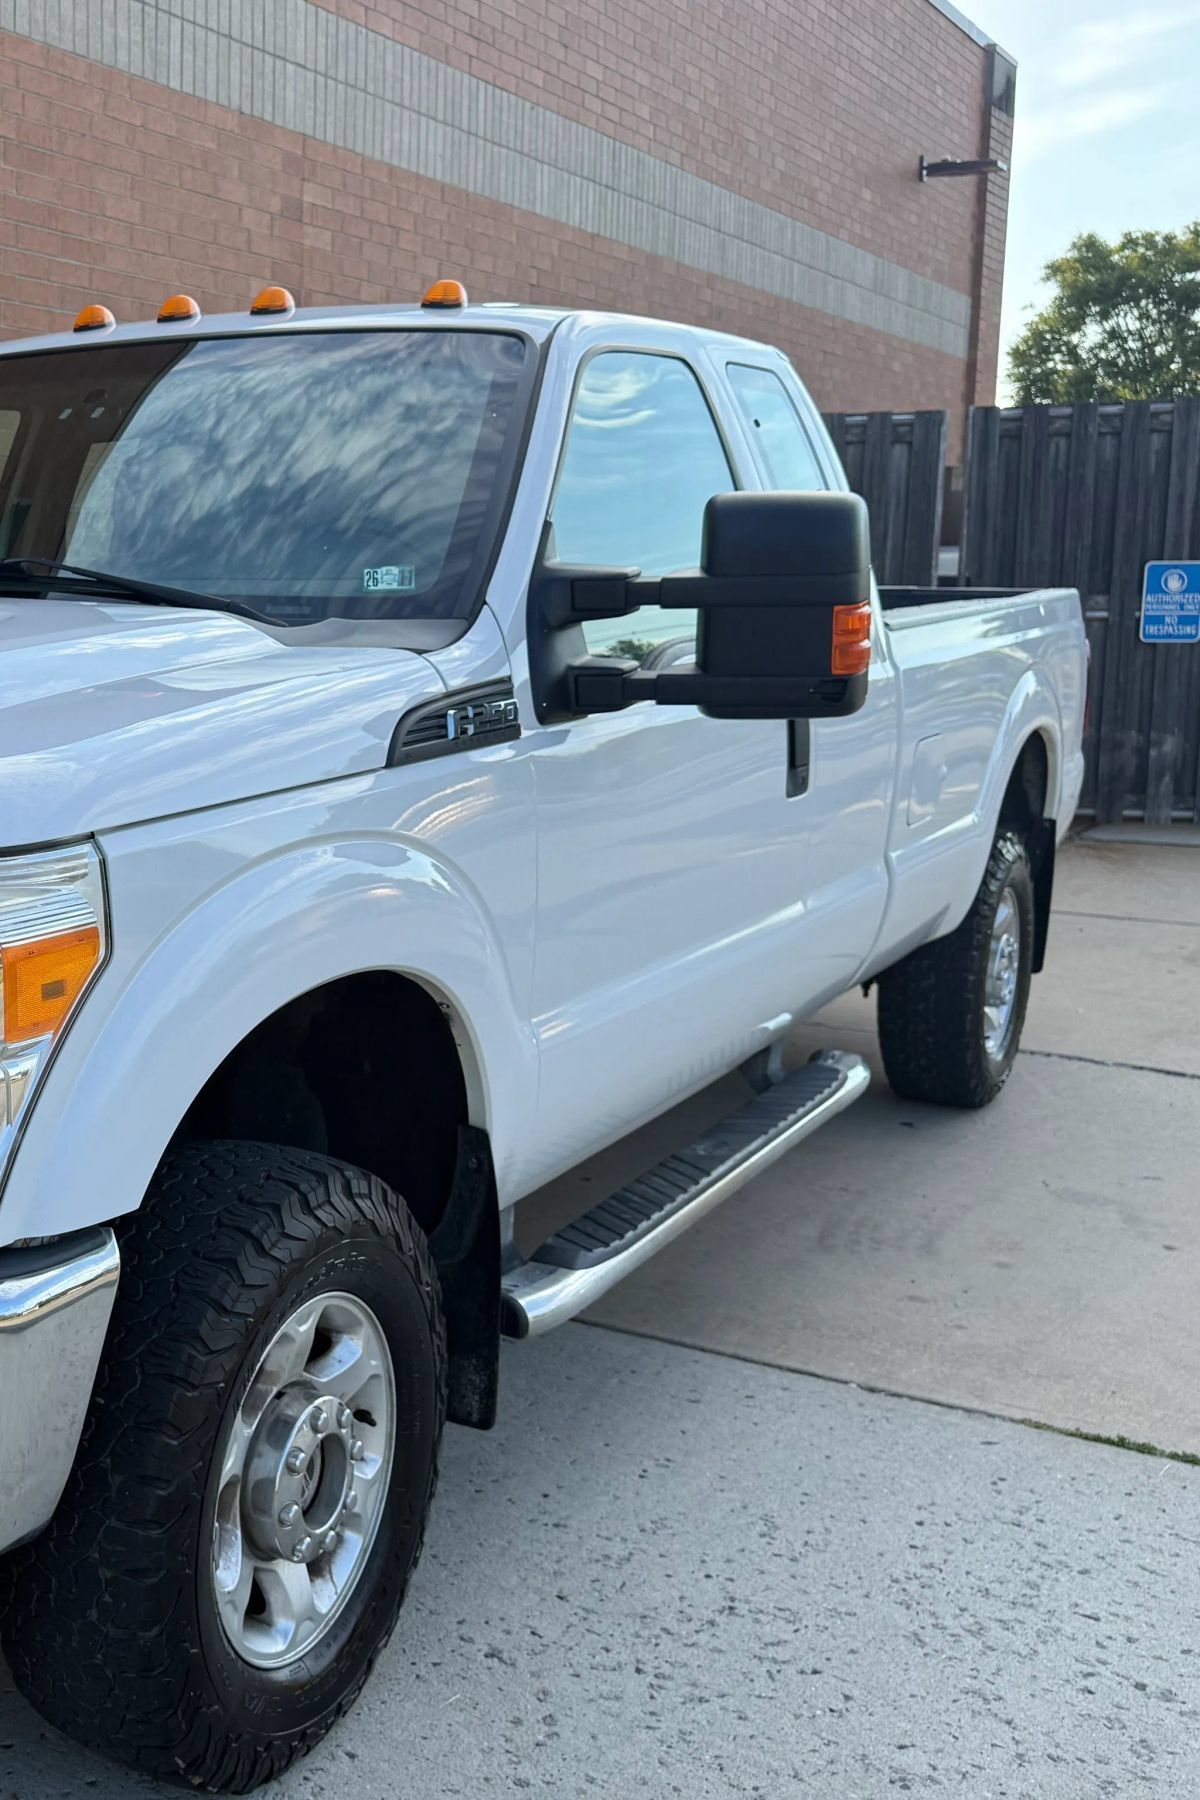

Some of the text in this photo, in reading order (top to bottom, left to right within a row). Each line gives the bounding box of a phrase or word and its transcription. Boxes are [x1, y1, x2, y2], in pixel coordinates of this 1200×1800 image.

[365, 570, 379, 588] 26
[1164, 615, 1178, 626] NO
[1145, 624, 1197, 636] TRESPASSING
